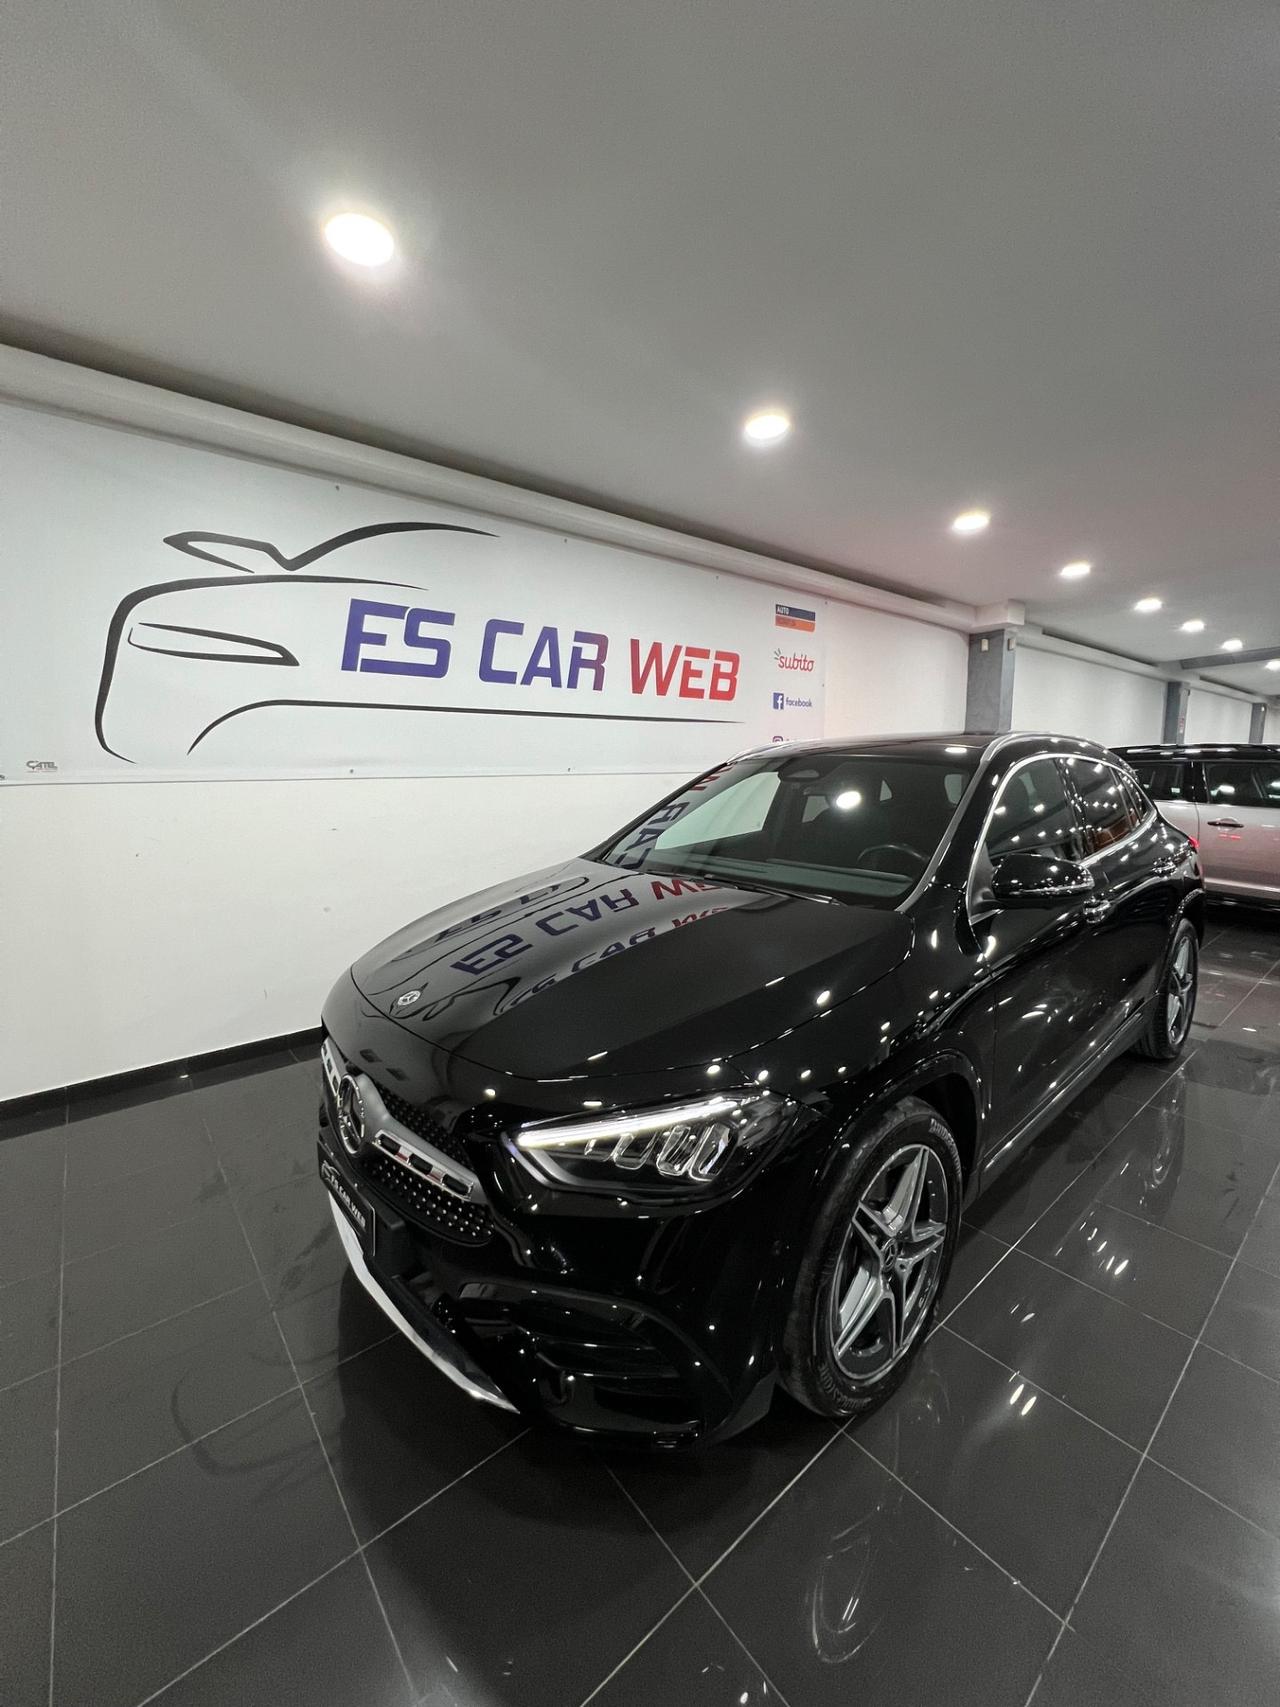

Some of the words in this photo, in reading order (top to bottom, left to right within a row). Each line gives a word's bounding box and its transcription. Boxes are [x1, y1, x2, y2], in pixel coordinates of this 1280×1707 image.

[341, 598, 456, 679] ES
[478, 618, 609, 691] CAR
[630, 637, 740, 701] WEB
[778, 652, 815, 672] subito
[785, 696, 812, 707] facebook
